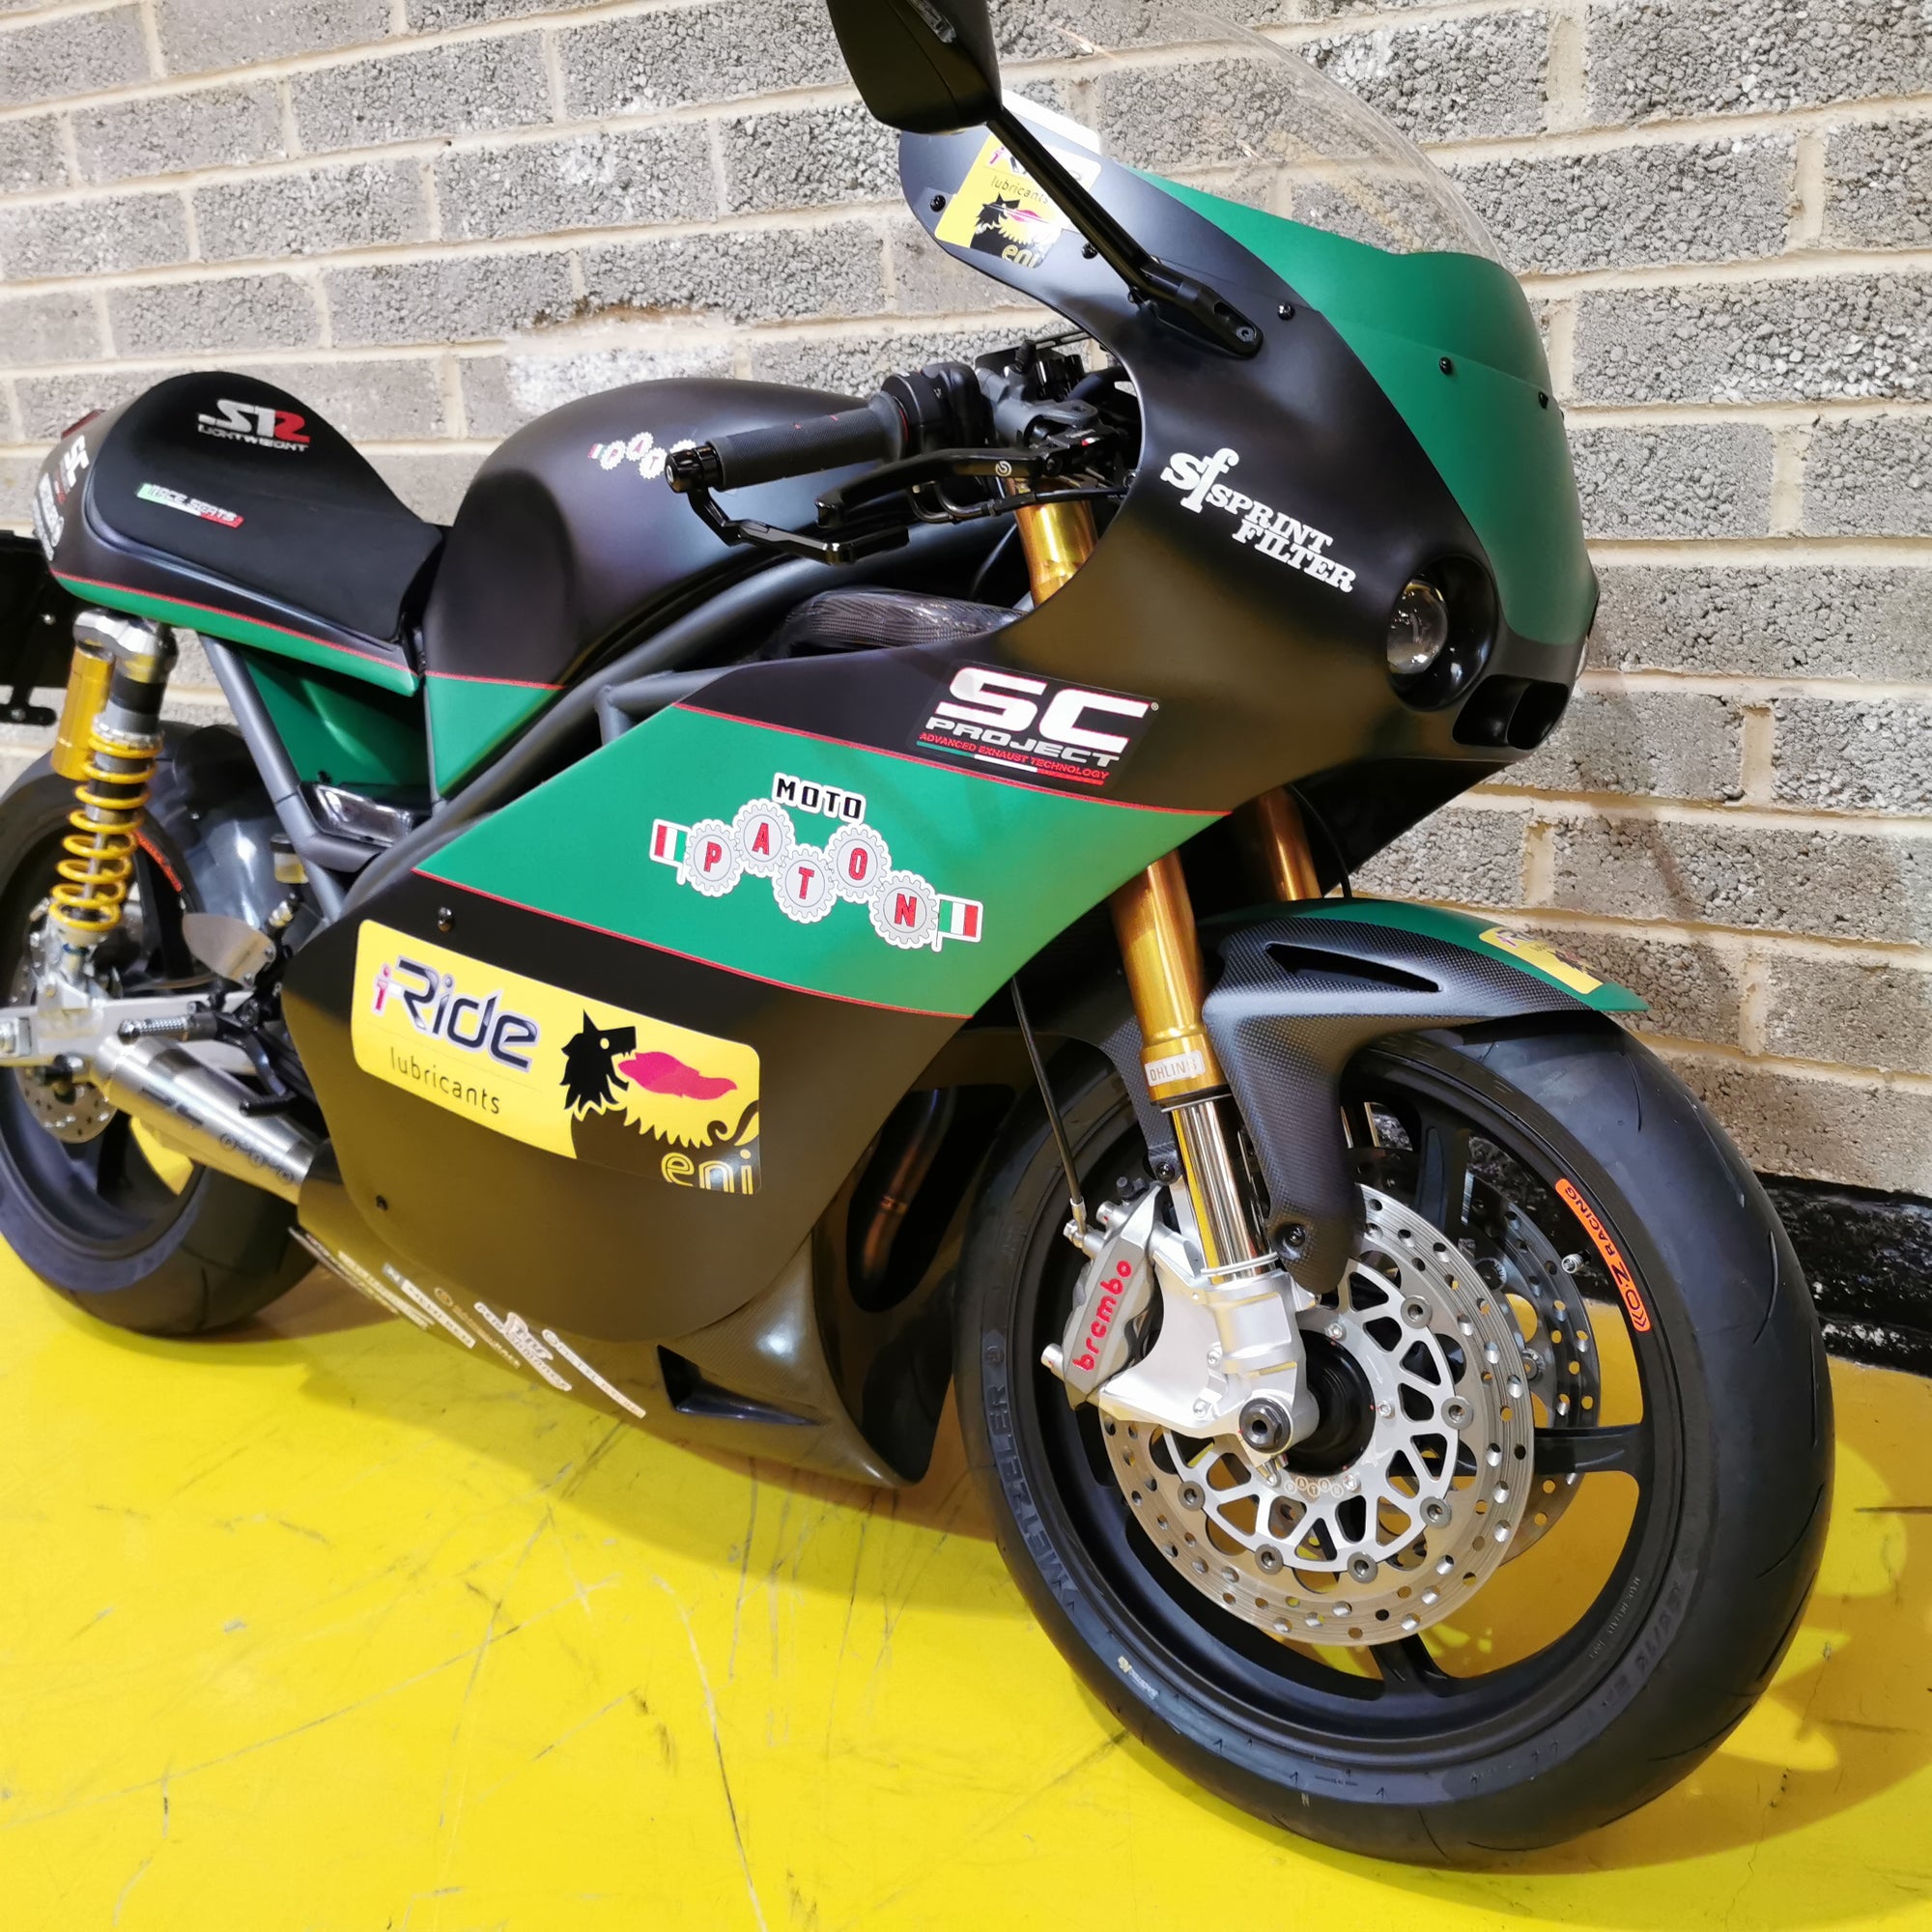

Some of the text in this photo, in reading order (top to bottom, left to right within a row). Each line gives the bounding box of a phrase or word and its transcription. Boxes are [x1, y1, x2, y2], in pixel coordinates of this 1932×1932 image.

[991, 176, 1049, 204] lubricants
[1206, 484, 1334, 554] SPRINT
[1232, 518, 1356, 593] FILTER
[925, 716, 1120, 767] PROJECT
[934, 667, 1151, 753] SC
[919, 732, 1110, 780] ADVANCED EXHAUST TECHNOLOGY
[776, 777, 863, 820] MOTO
[702, 821, 918, 928] PATON
[372, 956, 539, 1072] iRide
[389, 1046, 501, 1115] lubricants
[661, 1150, 753, 1195] eni
[1563, 1185, 1617, 1256] RACING
[1071, 1260, 1132, 1372] brembo
[985, 1382, 1076, 1587] METZELER
